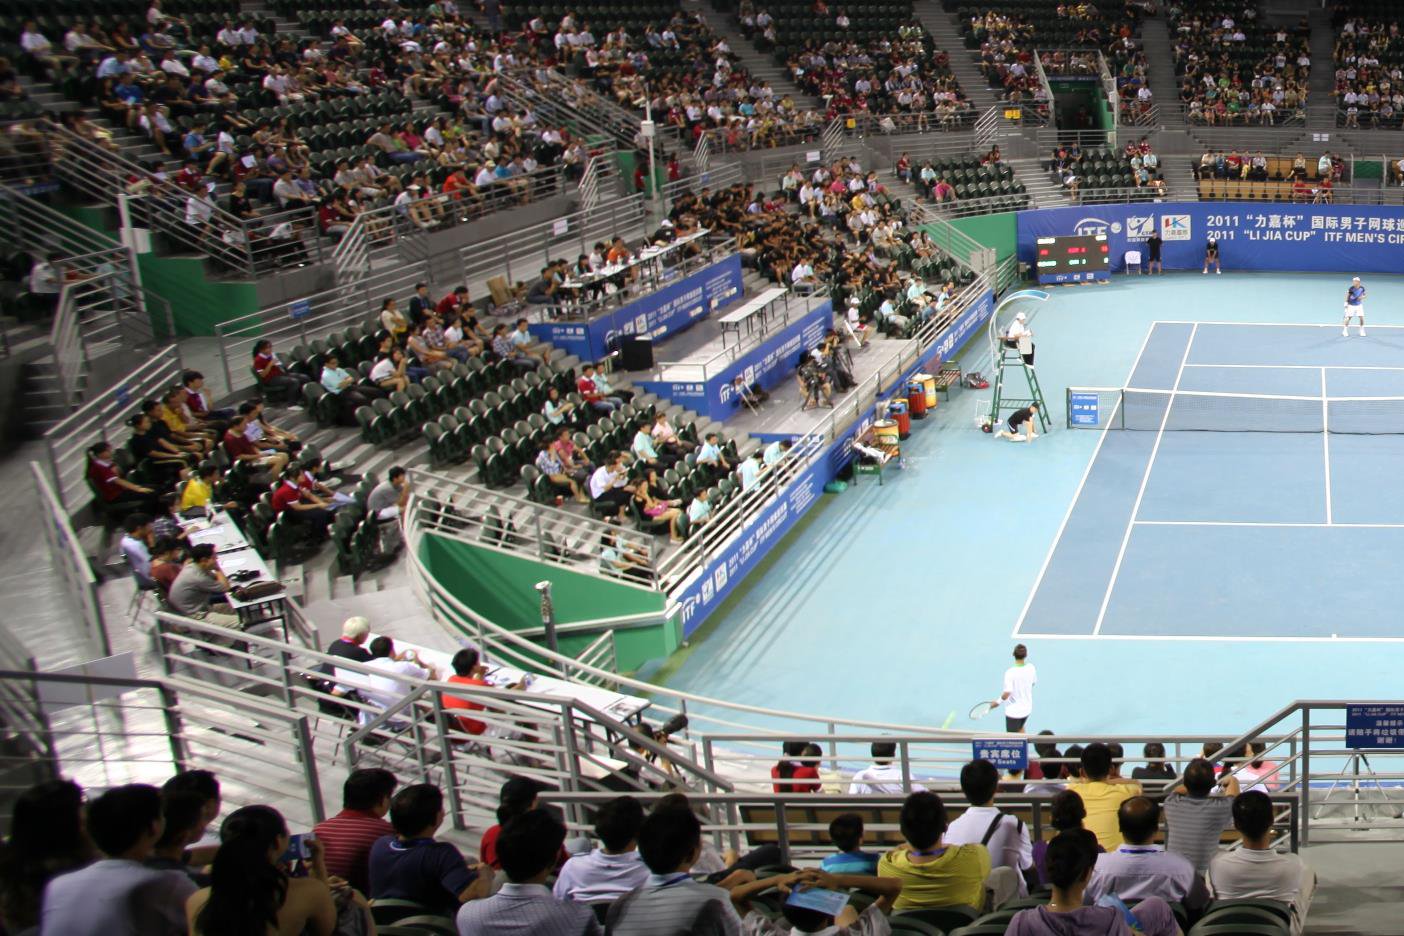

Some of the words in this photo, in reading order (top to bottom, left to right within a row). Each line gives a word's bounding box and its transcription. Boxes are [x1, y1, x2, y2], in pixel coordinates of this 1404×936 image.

[1207, 215, 1239, 227] 2011
[1206, 230, 1235, 240] 2011
[1262, 231, 1283, 240] JIA
[1324, 231, 1343, 242] ITF
[1345, 233, 1385, 243] MEN'S
